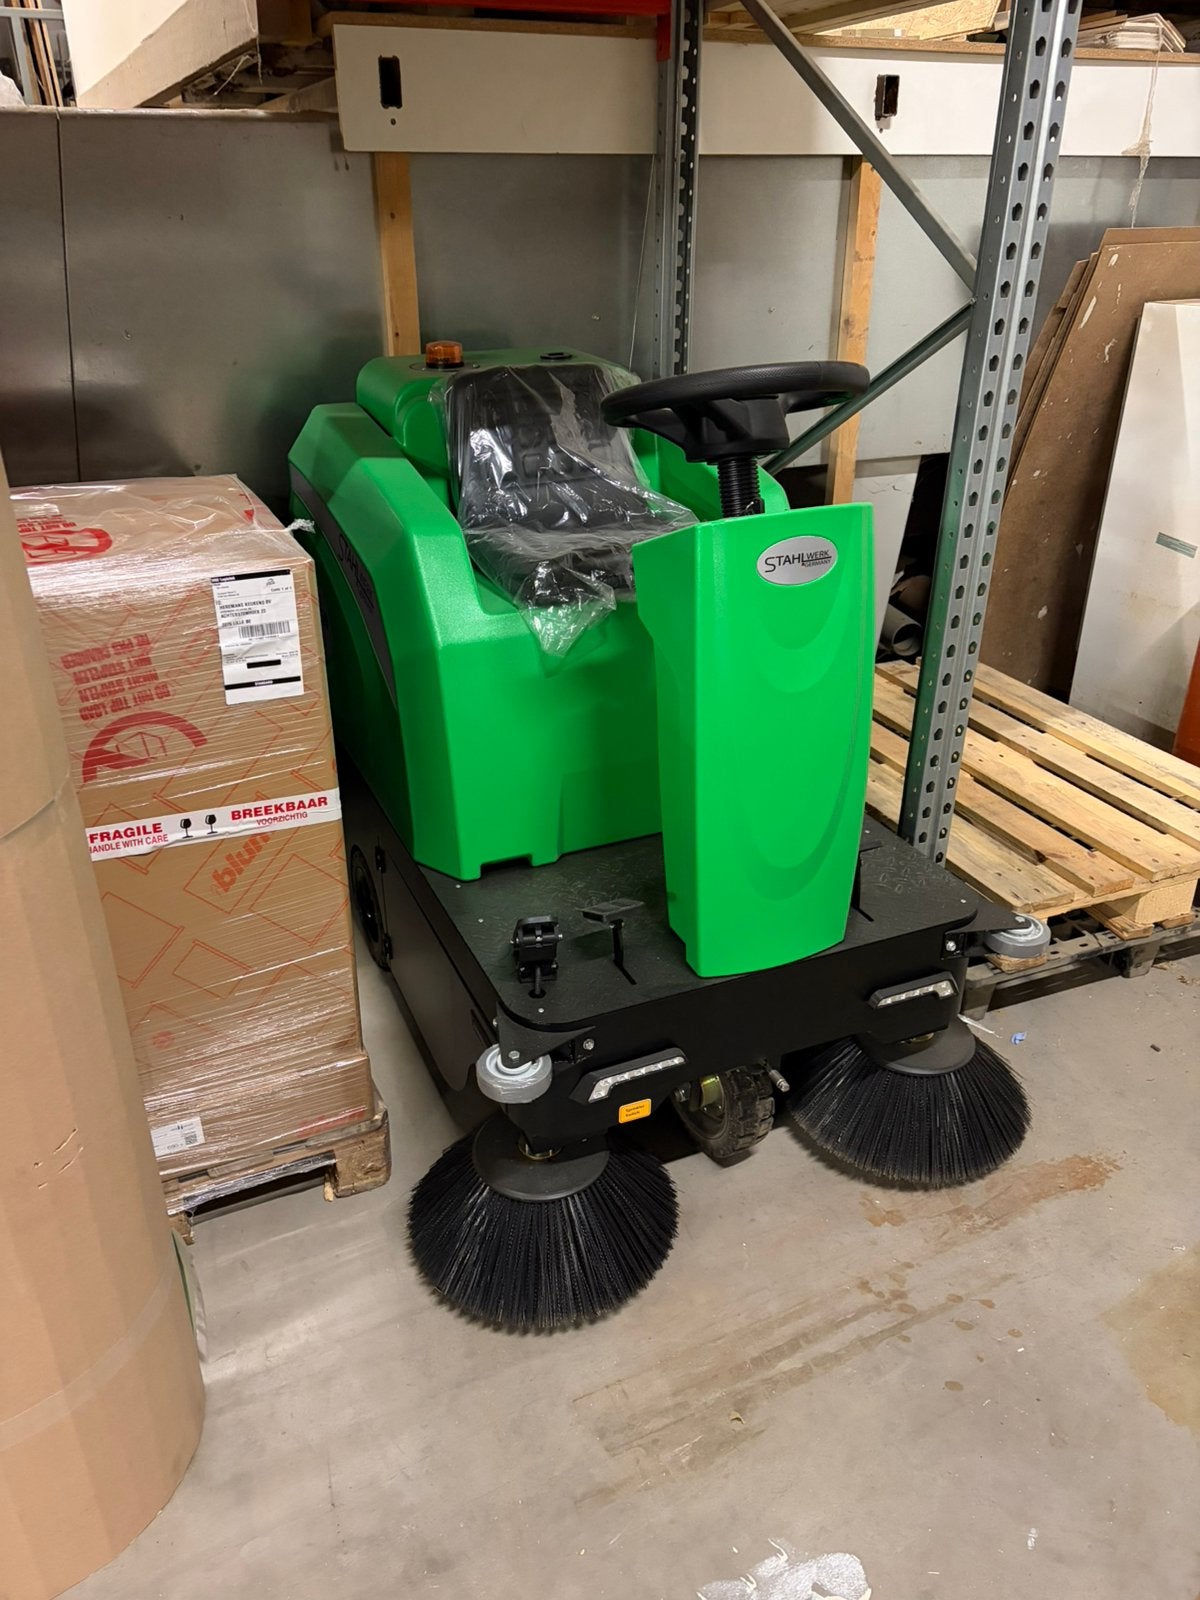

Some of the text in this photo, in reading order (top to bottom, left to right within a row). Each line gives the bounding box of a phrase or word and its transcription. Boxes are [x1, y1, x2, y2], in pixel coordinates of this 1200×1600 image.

[805, 559, 831, 567] GERMANY
[231, 796, 328, 821] BREEKBAAR
[256, 811, 308, 826] VOORZICHTIG
[89, 823, 163, 843] FRAGILE
[123, 839, 144, 849] WITH
[145, 834, 169, 845] CARE
